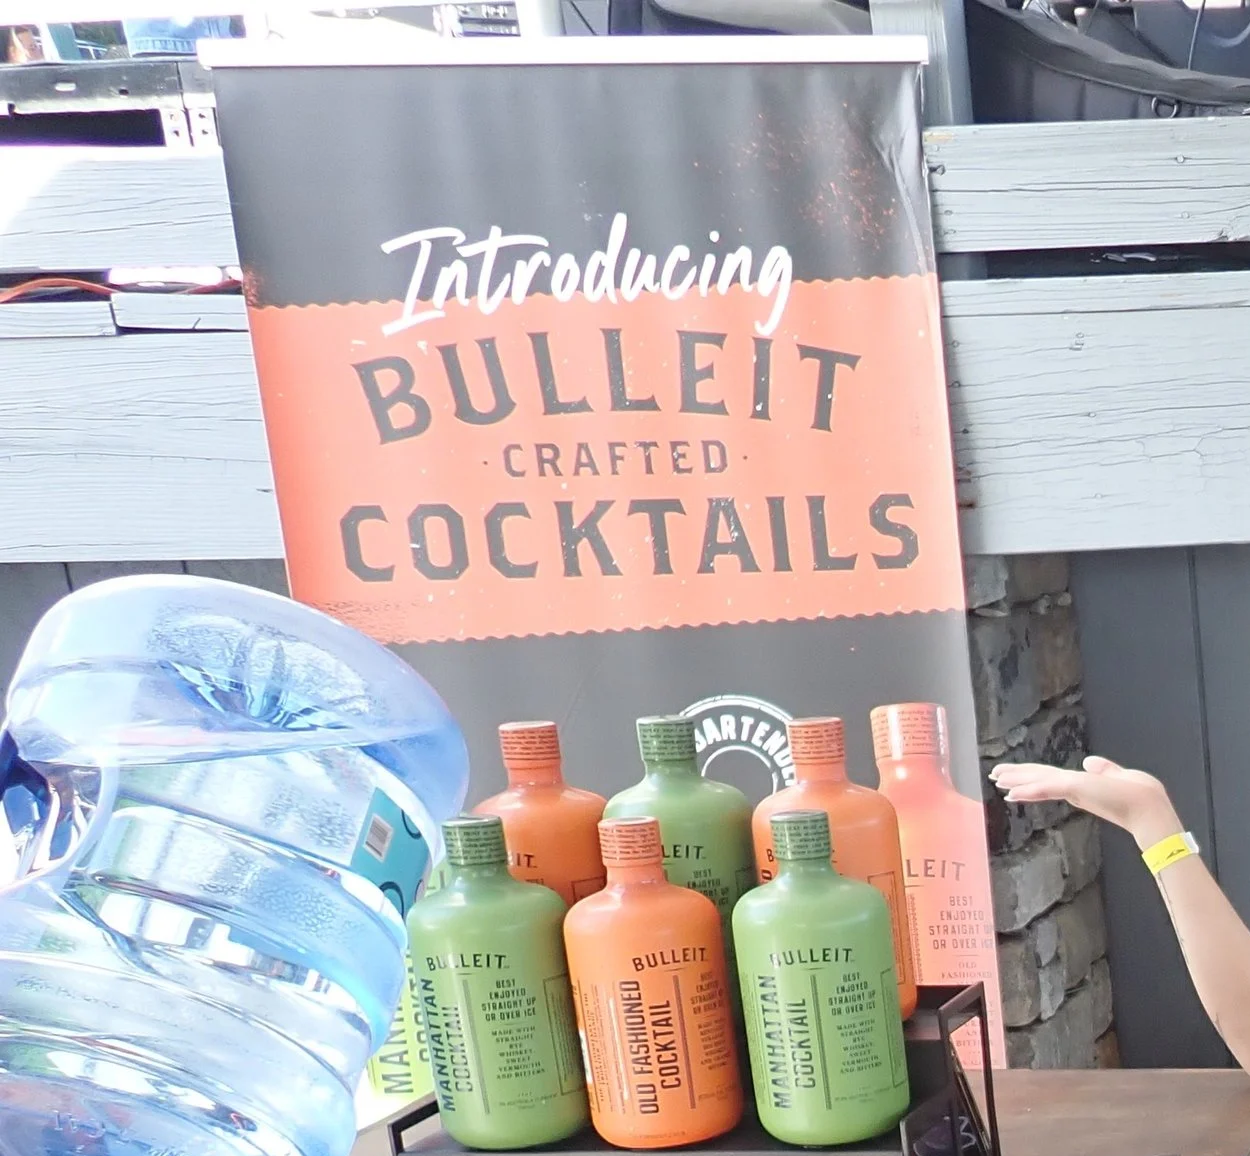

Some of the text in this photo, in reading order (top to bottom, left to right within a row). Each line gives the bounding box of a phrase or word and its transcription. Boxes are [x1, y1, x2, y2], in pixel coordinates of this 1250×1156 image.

[381, 212, 793, 337] Introducing
[351, 328, 862, 445] BULLEIT
[503, 440, 729, 478] CRAFTED
[339, 493, 919, 583] COCKTAILS
[905, 859, 966, 881] LEIT
[949, 895, 973, 906] BEST
[940, 910, 984, 921] ENJOYED
[929, 924, 980, 936] STRAIGHT
[933, 939, 946, 950] OR
[952, 939, 977, 949] OVER
[426, 953, 508, 971] BULEIT
[632, 947, 706, 972] BULLEIT
[495, 978, 516, 989] BEST
[843, 972, 860, 983] BEST
[489, 988, 526, 1000] ENJOYED
[836, 982, 868, 994] ENJOYED
[481, 997, 537, 1012] STRAIGHT UP
[828, 993, 865, 1006] STRAIGHT
[485, 1008, 537, 1022] OR OVER ICE
[831, 1007, 842, 1016] OR
[846, 1005, 863, 1014] OVER
[420, 978, 456, 1112] MANHATTAN
[619, 980, 660, 1115] OLD FASHIONED
[648, 1000, 682, 1090] COCKTAIL
[757, 975, 792, 1109] MANHATTAN
[786, 998, 816, 1089] COCKTAIL
